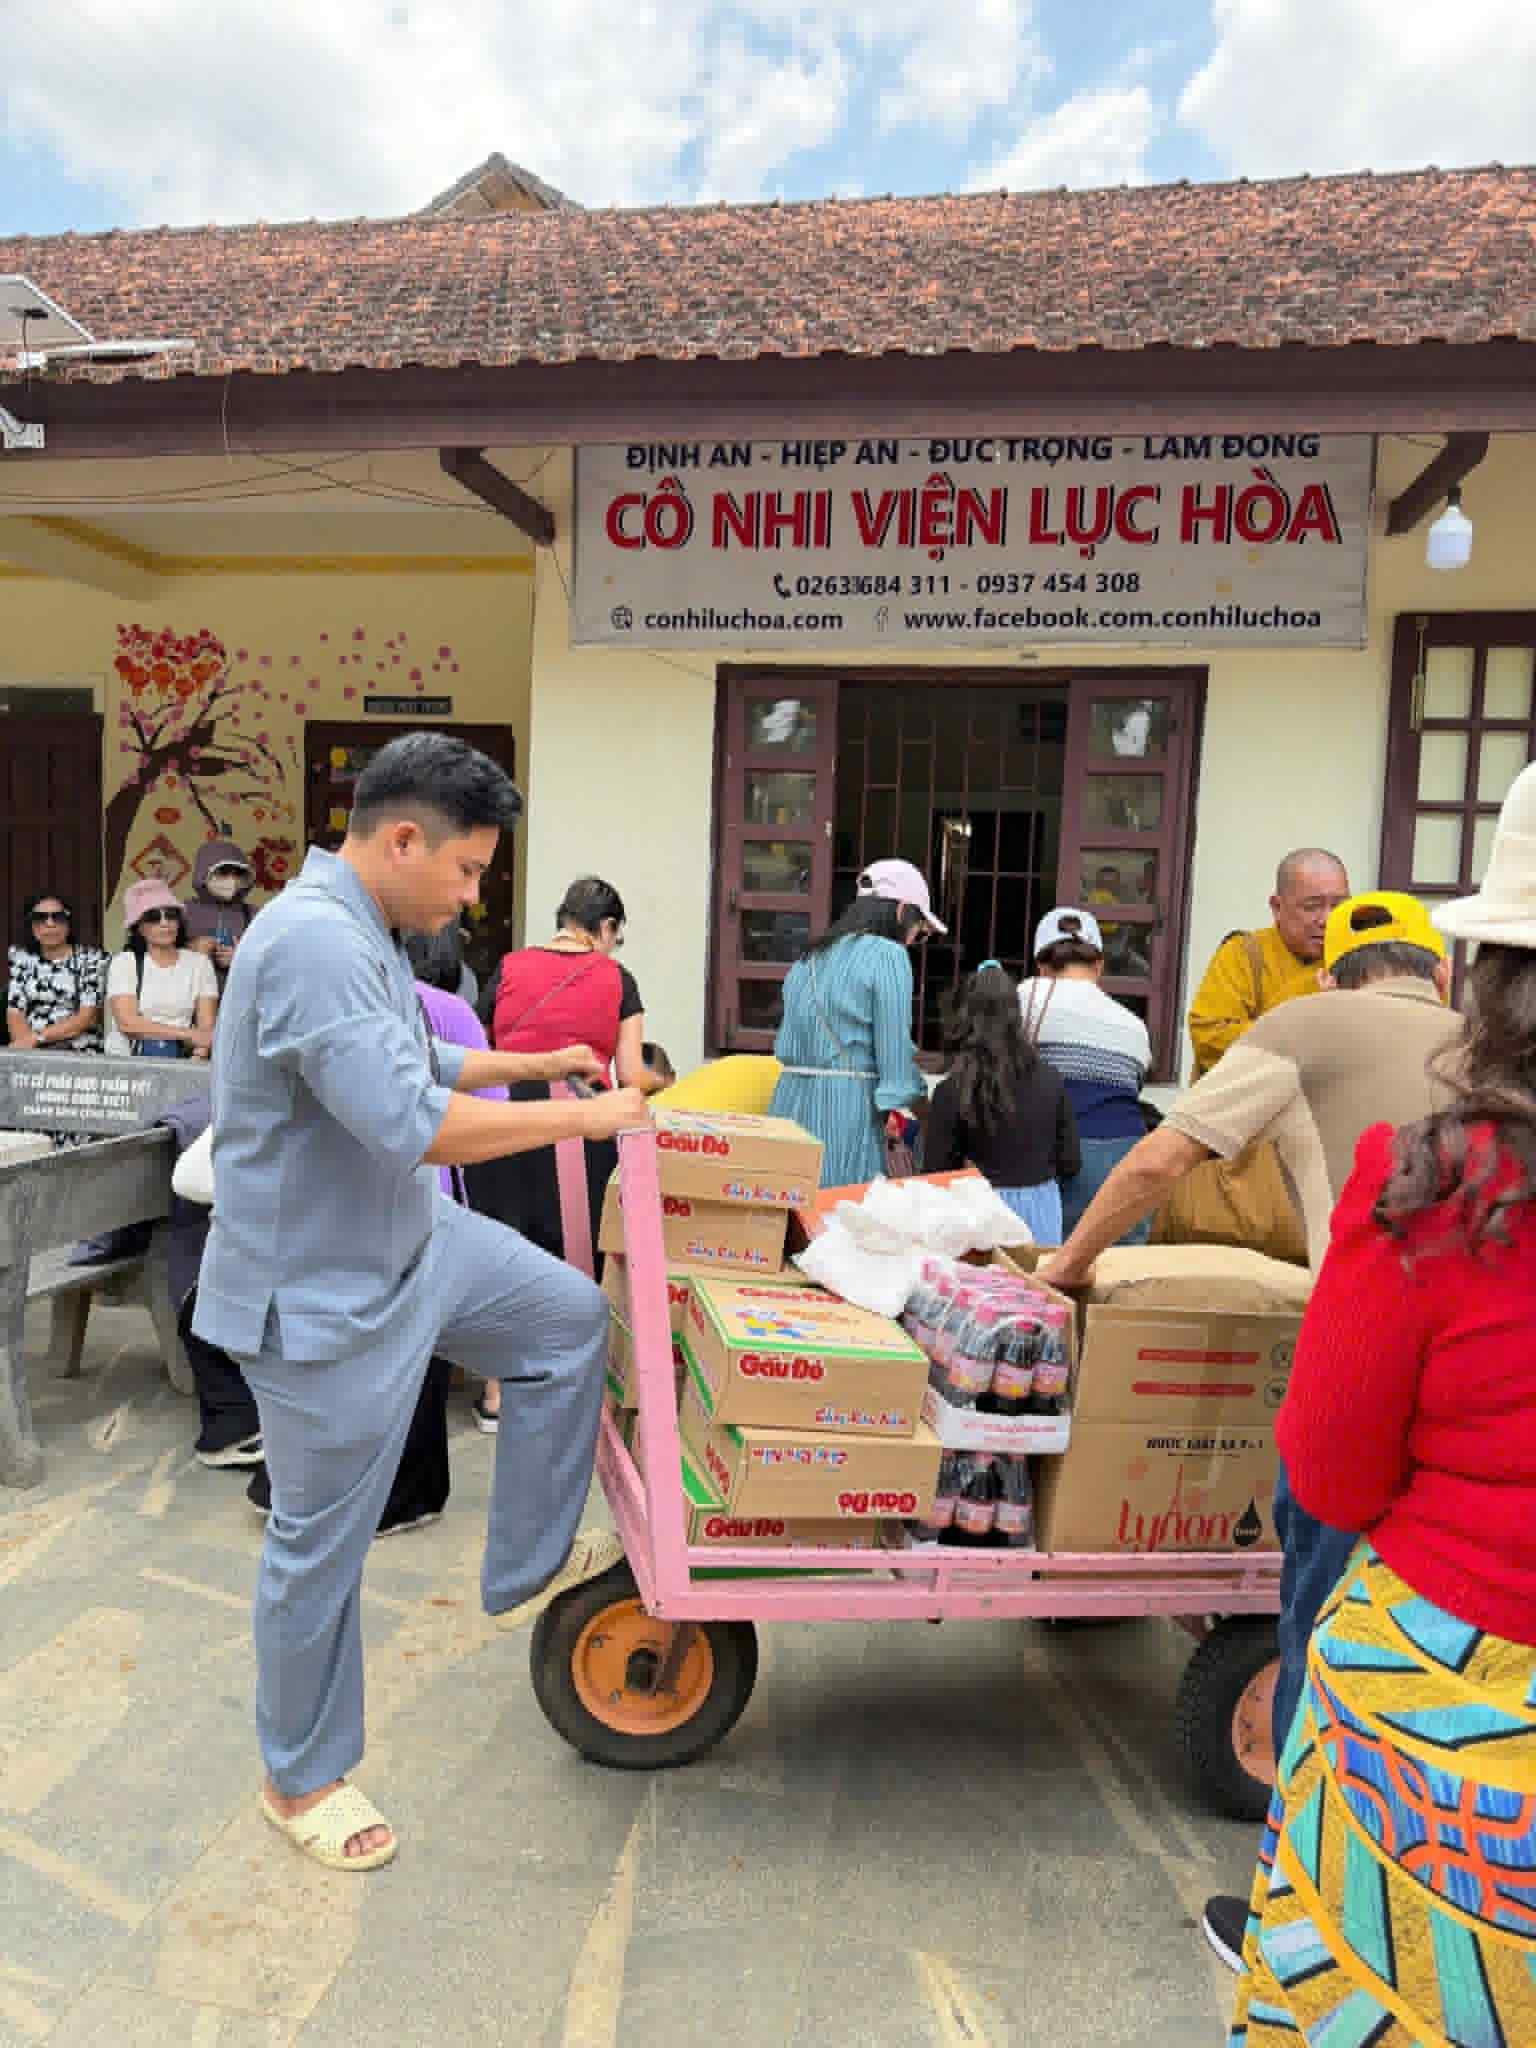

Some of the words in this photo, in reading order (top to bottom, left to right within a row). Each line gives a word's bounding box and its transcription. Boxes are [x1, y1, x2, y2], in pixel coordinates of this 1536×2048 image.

[708, 442, 752, 467] AN
[855, 439, 899, 465] AN
[1004, 436, 1113, 468] TRỌNG
[605, 475, 694, 551] CÔ
[711, 488, 832, 551] NHI
[851, 471, 1007, 562] VIỆN
[1029, 484, 1160, 560] LỤC
[1179, 466, 1342, 546] HÒA
[911, 575, 950, 595] 311
[976, 573, 1035, 594] 0937
[1043, 573, 1088, 593] 454
[1095, 572, 1141, 594] 308
[644, 606, 844, 631] conhiluchoa.com
[904, 604, 1321, 630] www.facebook.com.conhiluchoa
